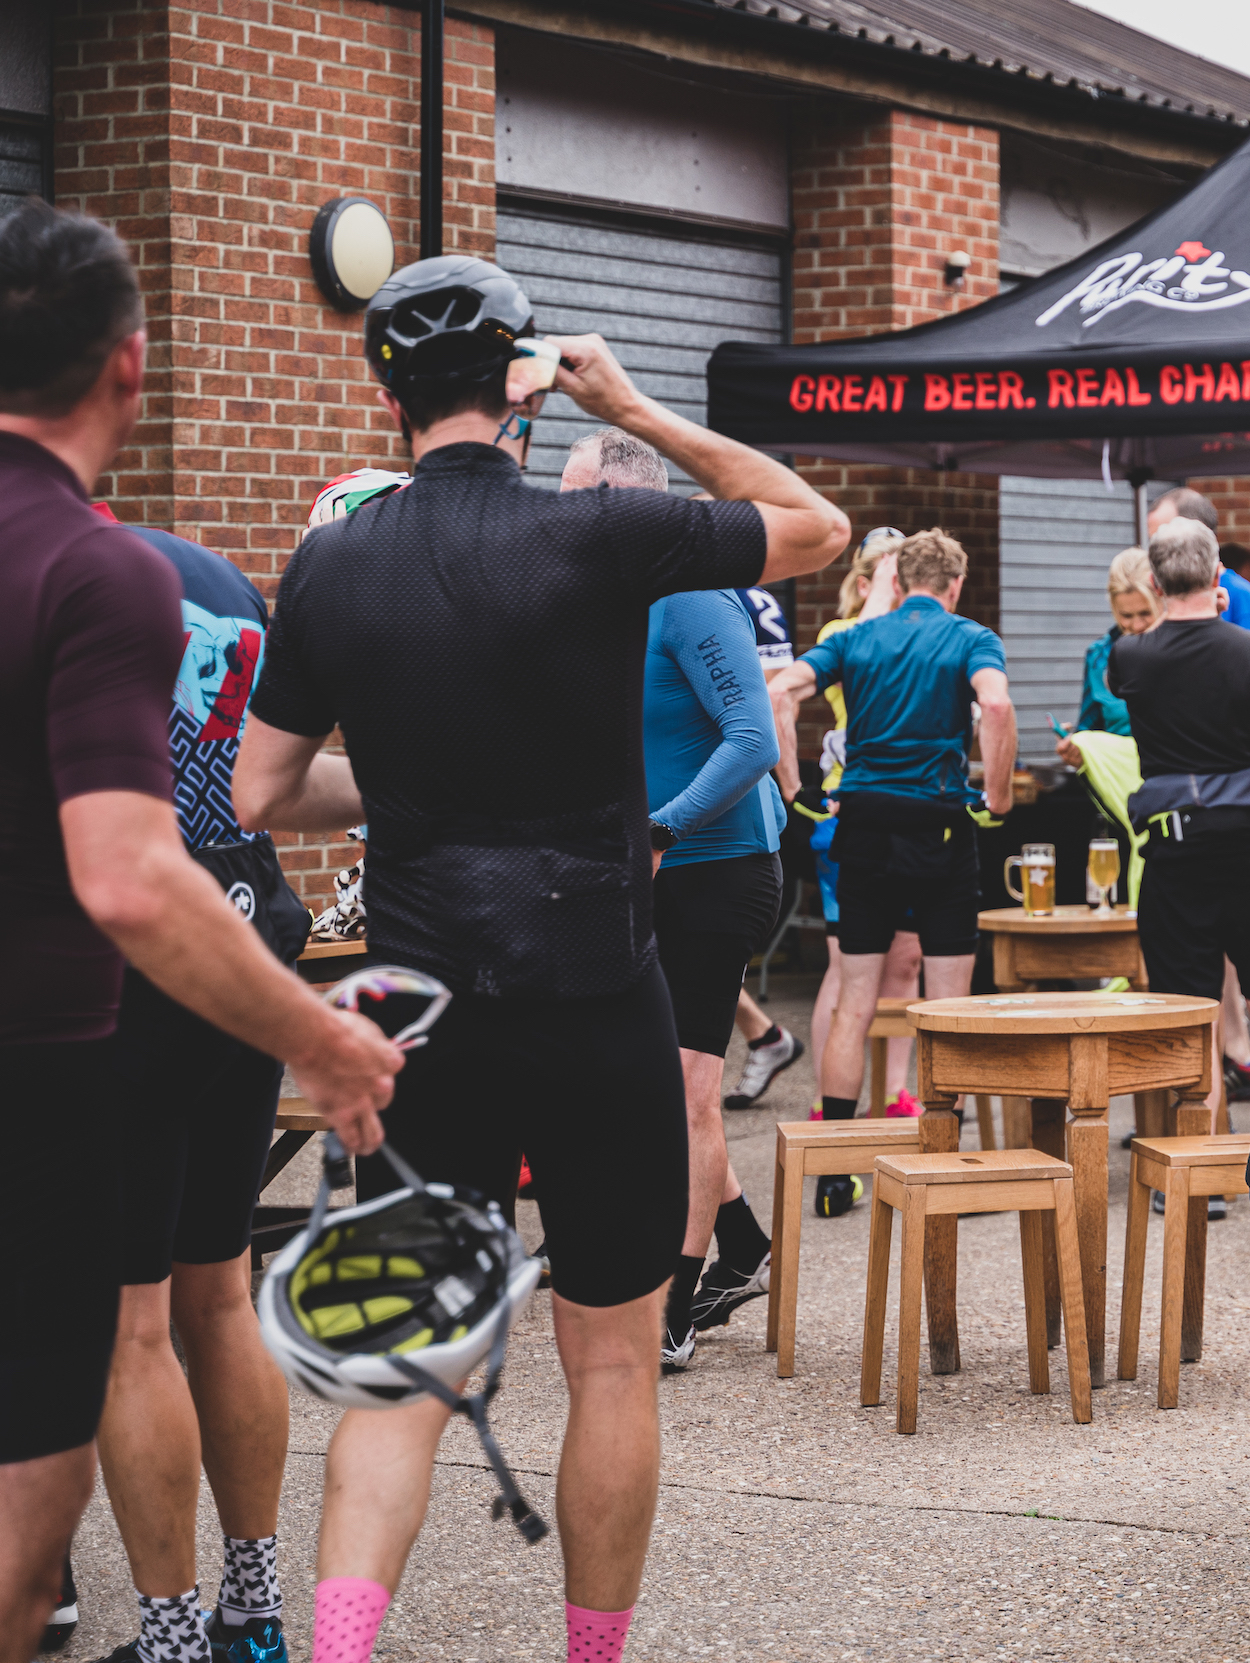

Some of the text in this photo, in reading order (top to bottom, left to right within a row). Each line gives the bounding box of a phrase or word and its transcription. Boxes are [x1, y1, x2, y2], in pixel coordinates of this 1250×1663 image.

[789, 375, 908, 412] GREAT
[924, 370, 1036, 411] BEER.
[1046, 367, 1151, 409] REAL
[697, 633, 746, 708] RAPHA
